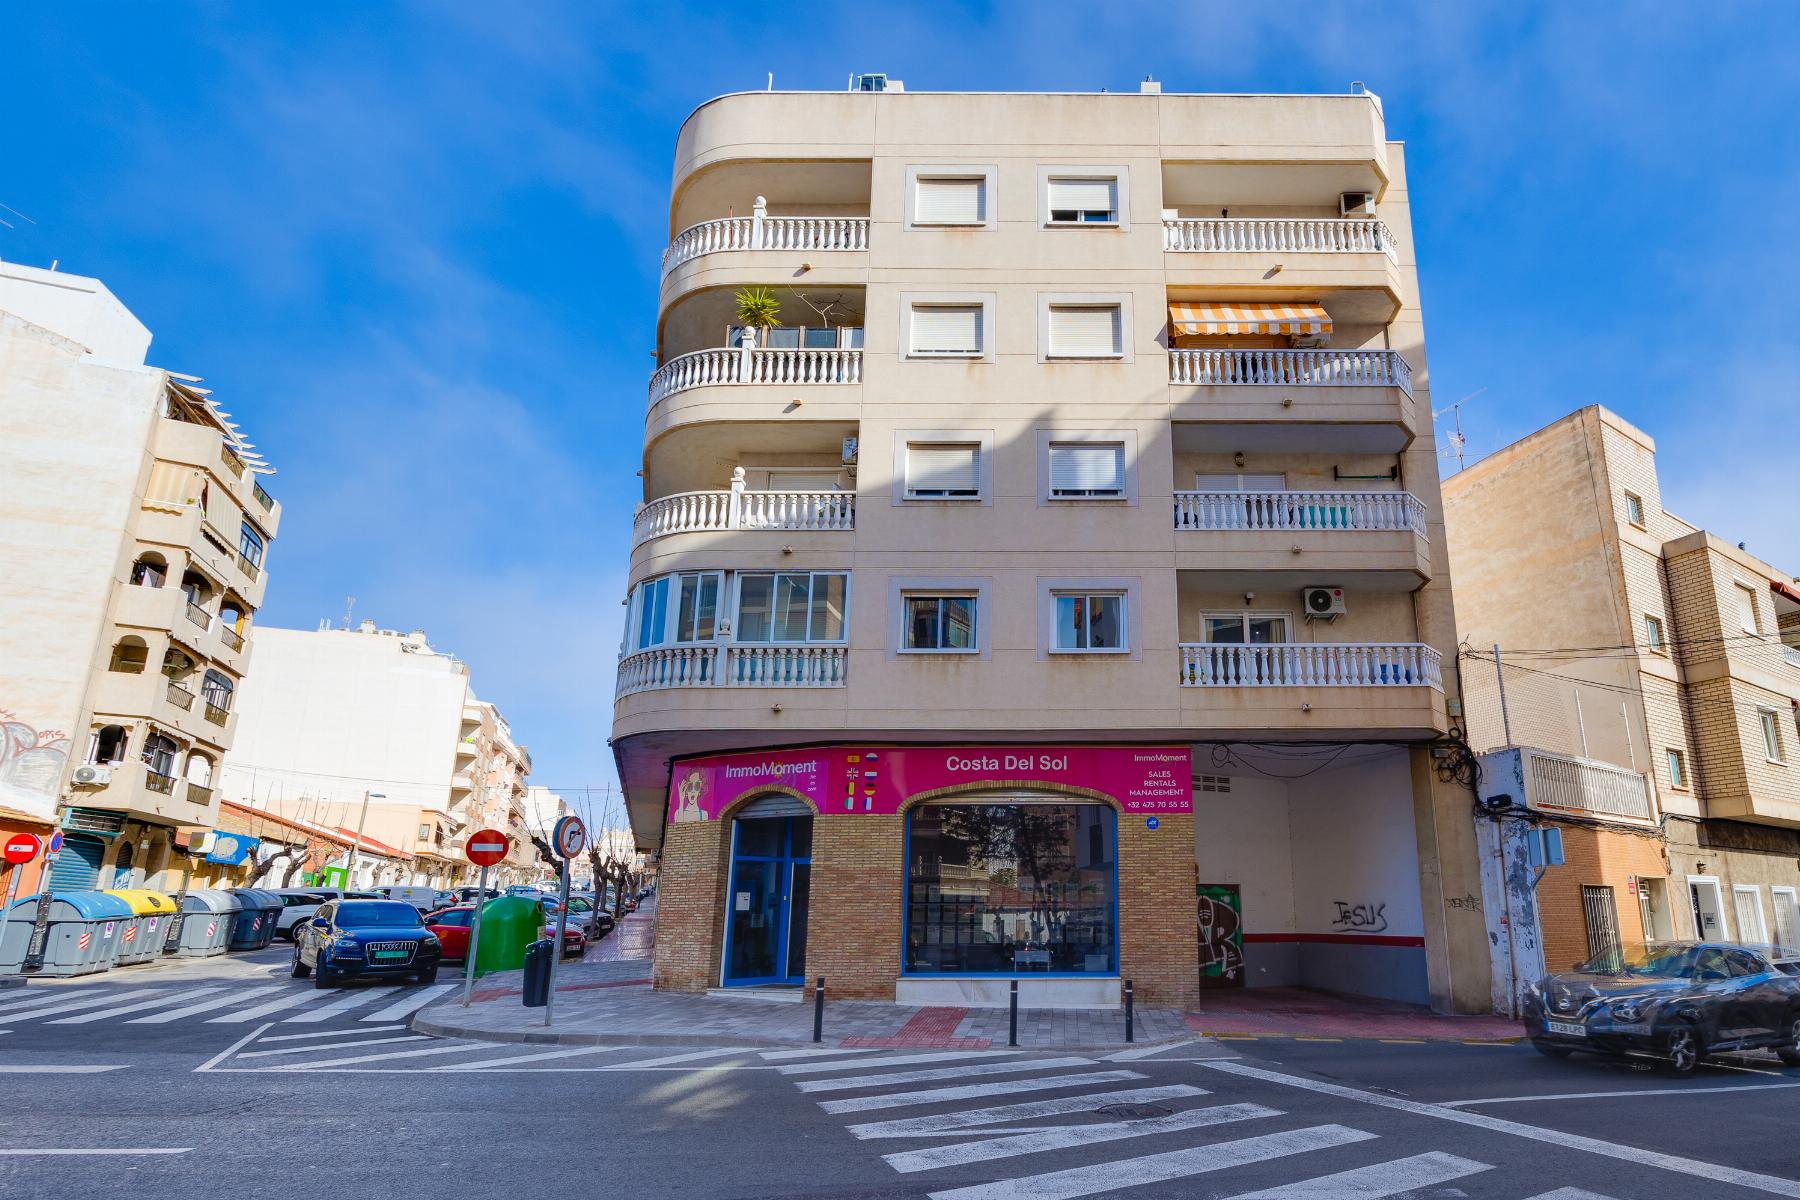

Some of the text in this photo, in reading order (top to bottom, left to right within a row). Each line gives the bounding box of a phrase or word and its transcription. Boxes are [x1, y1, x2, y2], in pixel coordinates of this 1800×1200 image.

[946, 755, 1068, 771] Costa Del Sol
[1134, 753, 1187, 762] ImmoMoment
[725, 760, 817, 778] ImmoMoment
